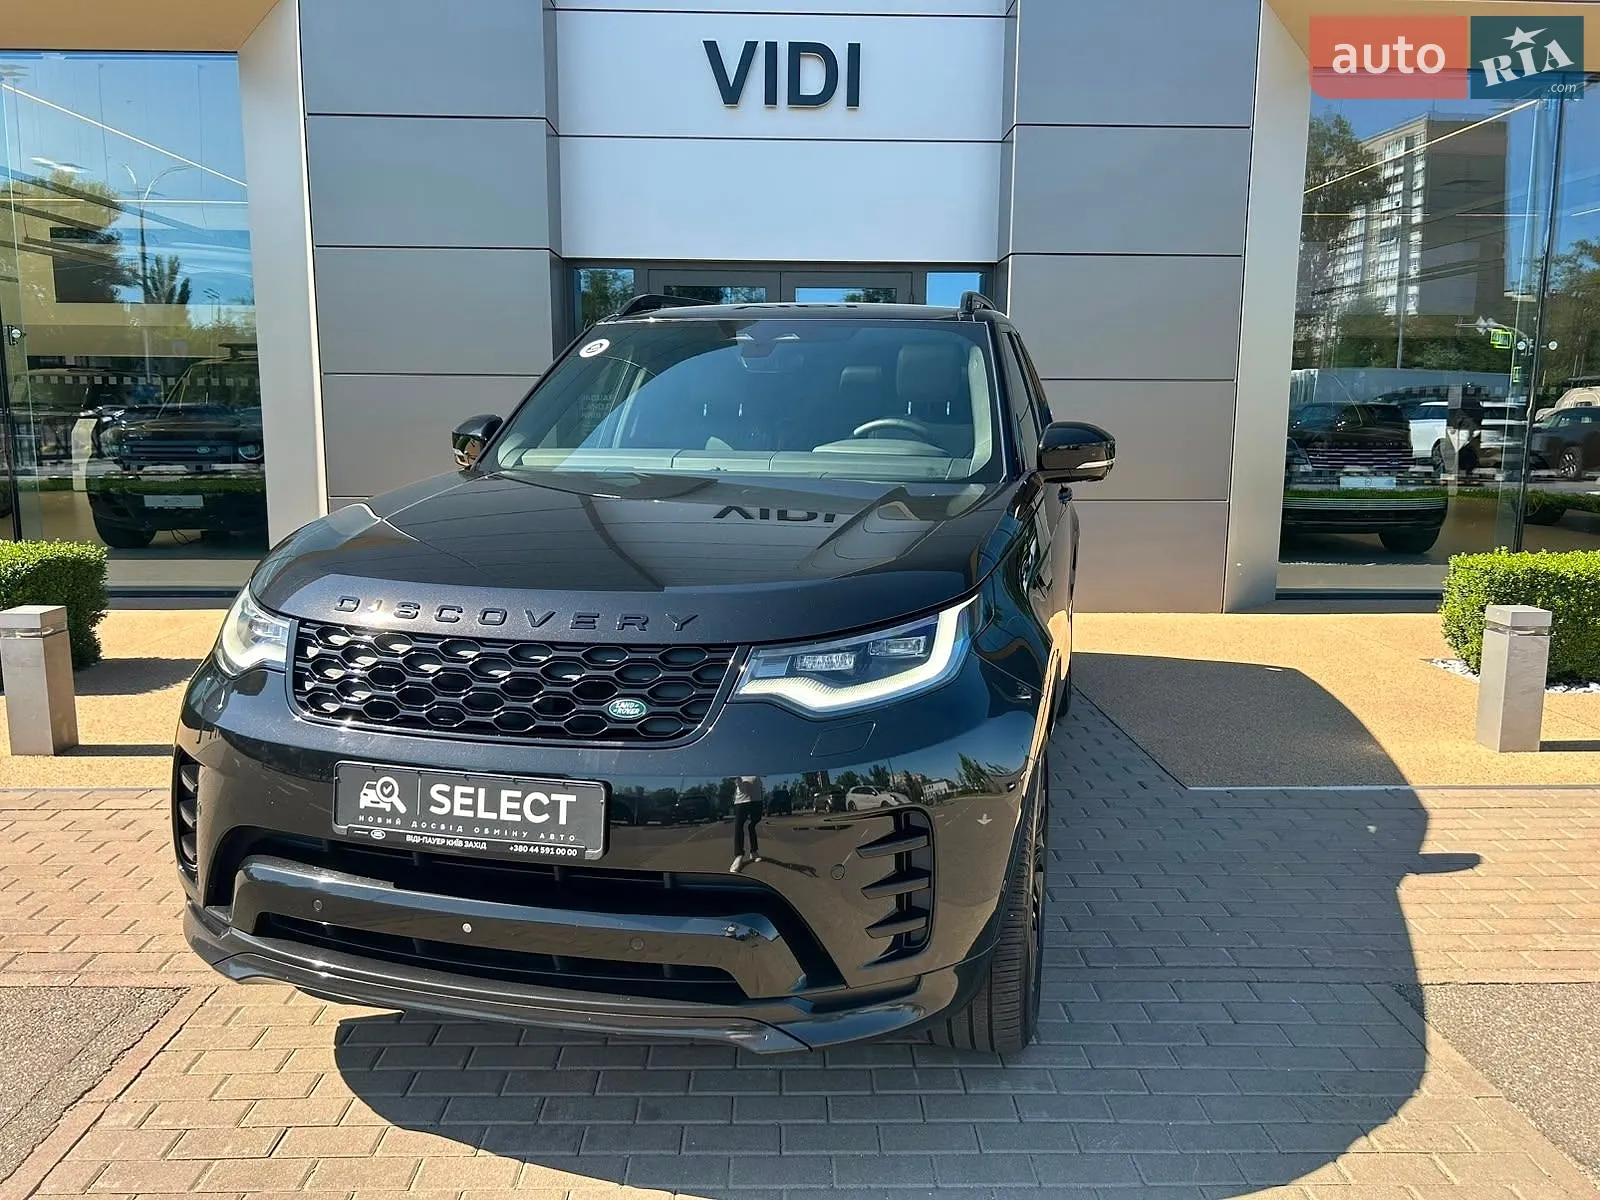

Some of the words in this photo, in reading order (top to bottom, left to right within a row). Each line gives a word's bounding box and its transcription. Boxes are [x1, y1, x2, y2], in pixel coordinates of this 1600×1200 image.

[702, 40, 861, 108] VIDI
[334, 595, 699, 632] DISCOVERY
[429, 783, 577, 825] SELECT
[358, 815, 401, 825] НОВИЙ
[411, 820, 463, 833] ДОСВІД
[473, 826, 528, 838] ОБМІНУ
[539, 832, 576, 842] АВТО
[446, 838, 463, 848] КИЇВ
[464, 840, 487, 850] ЗАХІД
[509, 844, 528, 853] +380
[529, 845, 540, 854] 44
[540, 846, 555, 855] 591
[555, 848, 566, 856] 00
[567, 848, 578, 857] 00
